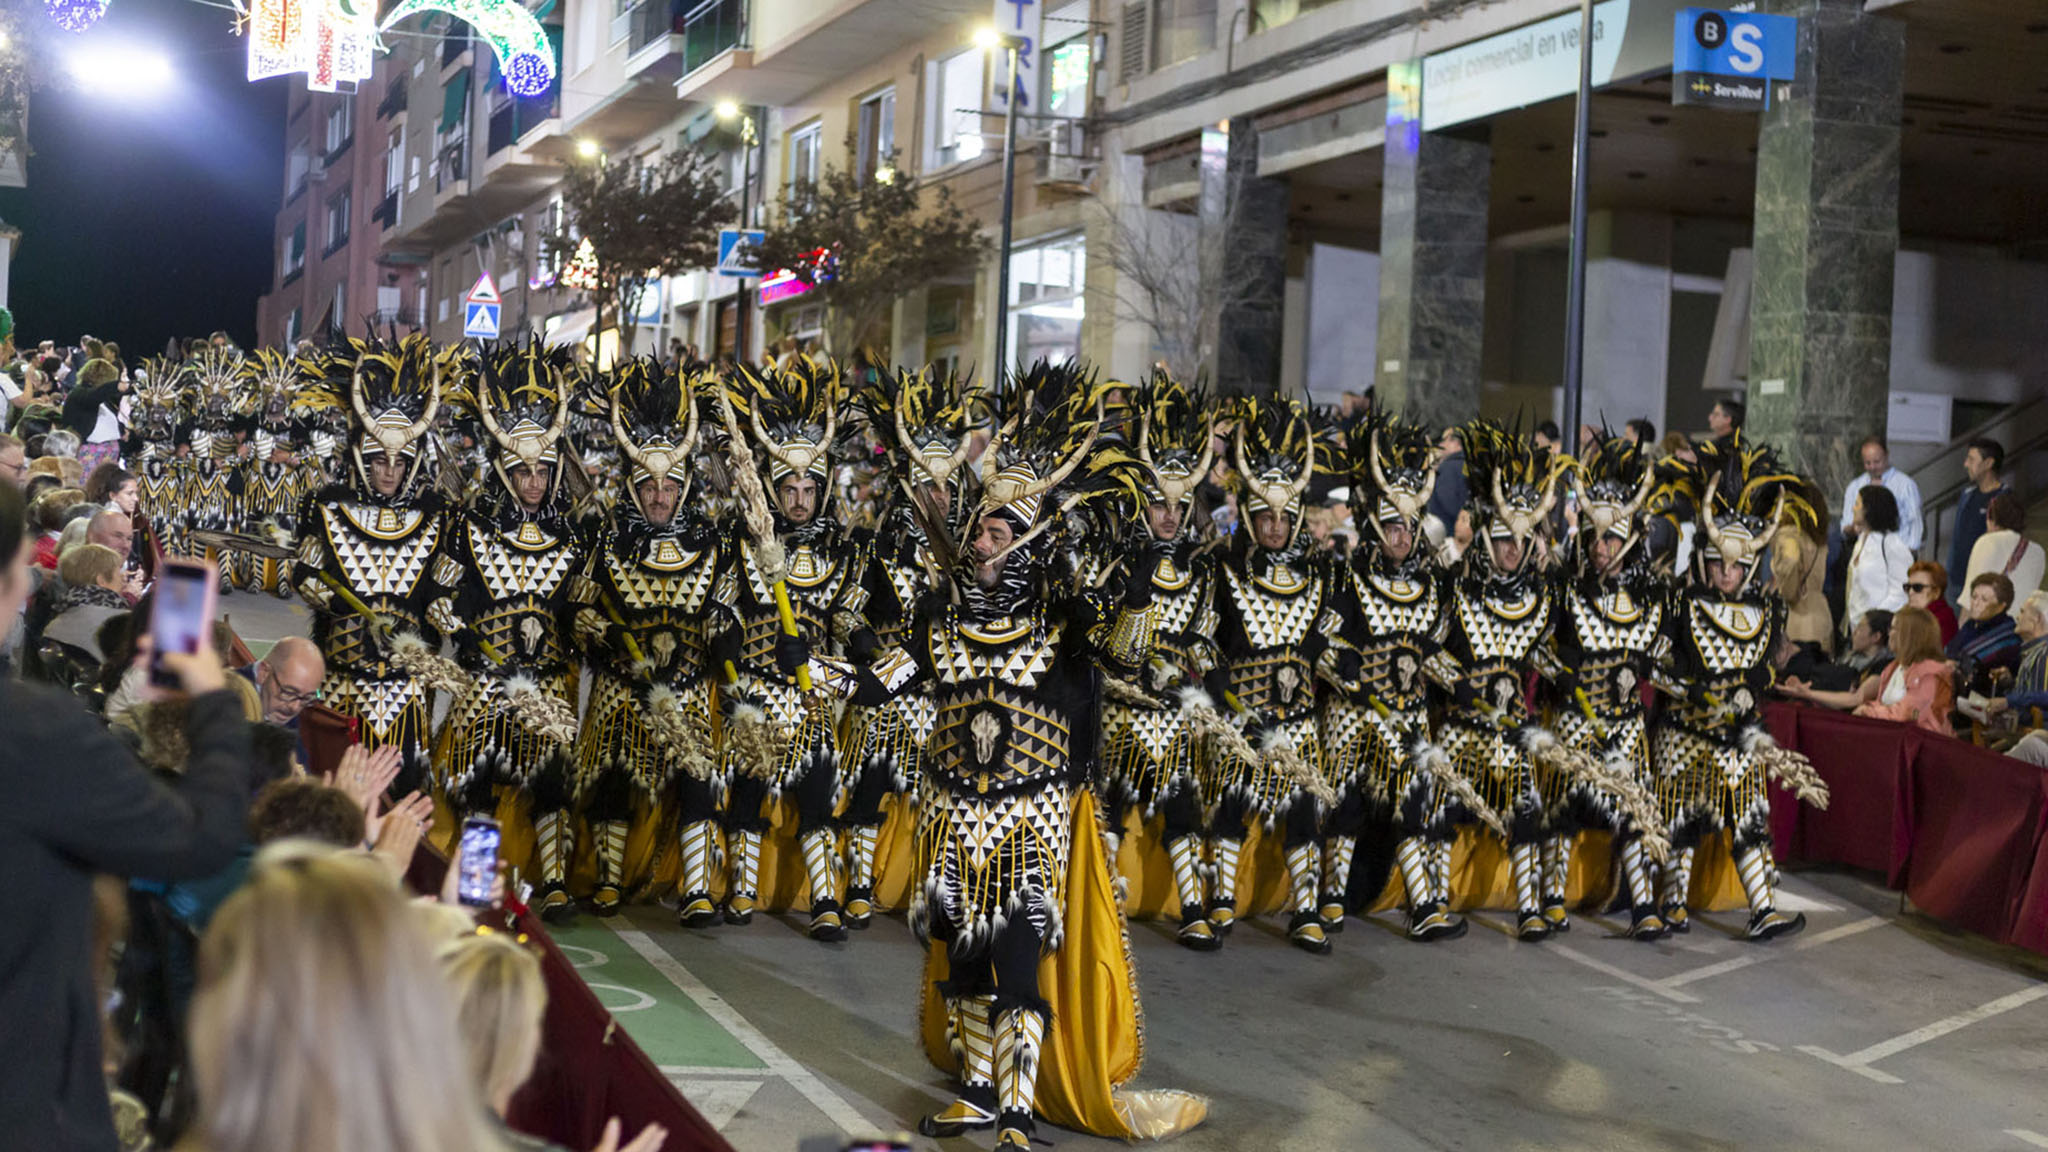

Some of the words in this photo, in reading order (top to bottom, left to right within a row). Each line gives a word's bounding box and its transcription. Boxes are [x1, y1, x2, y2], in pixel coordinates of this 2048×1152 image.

[1538, 33, 1556, 57] en
[1561, 20, 1604, 48] vea
[1728, 23, 1764, 72] S
